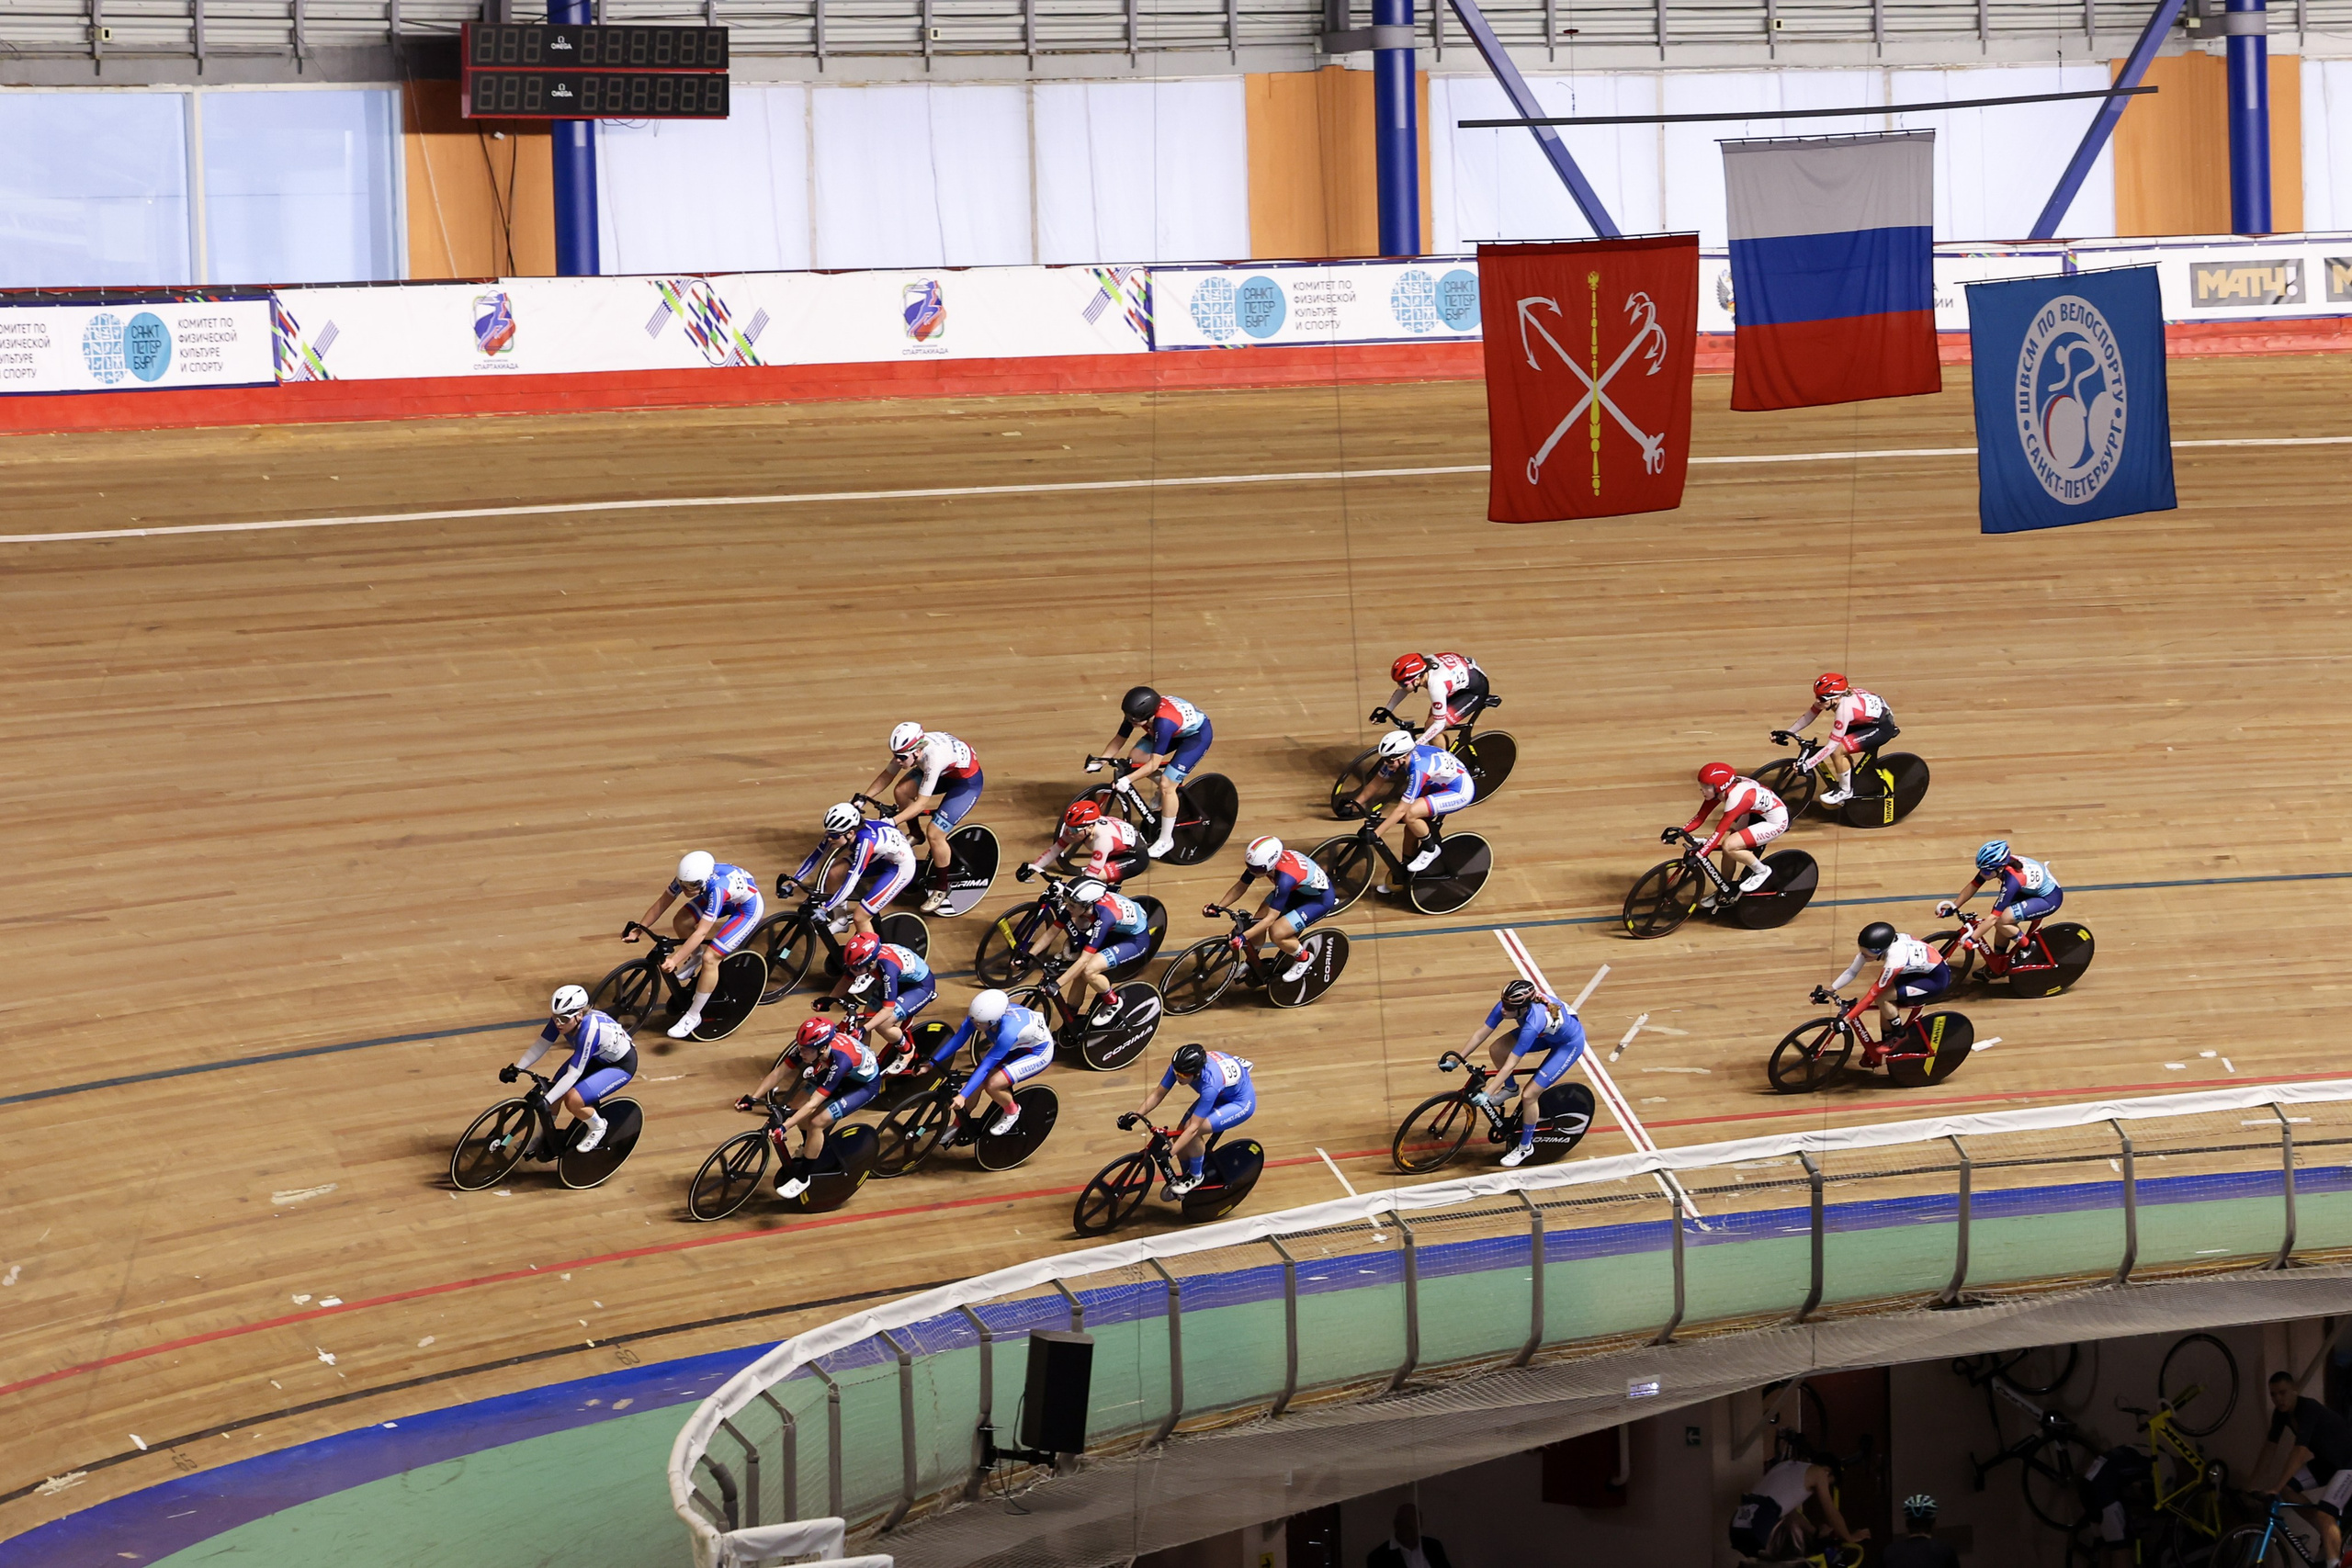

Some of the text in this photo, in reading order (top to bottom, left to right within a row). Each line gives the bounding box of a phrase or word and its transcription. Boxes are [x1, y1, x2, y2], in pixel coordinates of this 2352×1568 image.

[1293, 280, 1352, 291] КОМИТЕТ ПО
[1444, 280, 1475, 293] САНКТ
[2197, 266, 2298, 299] МАТЧ!
[1244, 288, 1274, 300] САНКТ
[1294, 291, 1356, 304] ФИЗИЧЕСКОЙ
[1445, 294, 1476, 307] ПЕТЕР
[1244, 301, 1275, 314] ПЕТЕР
[1295, 307, 1338, 317] КУЛЬТУРЕ
[1245, 315, 1270, 327] БУРГ
[1446, 308, 1471, 321] БУРГ
[34, 323, 46, 333] ПО
[178, 317, 233, 329] КОМИТЕТ ПО
[1295, 321, 1341, 330] И СПОРТУ
[131, 325, 159, 339] САНКТ
[178, 330, 237, 343] ФИЗИЧЕСКОЙ
[0, 336, 51, 349] ИЗИЧЕСКОЙ
[132, 340, 162, 354] ПЕТЕР
[0, 354, 34, 364] УЛЬТУРЕ
[180, 347, 220, 358] КУЛЬТУРЕ
[2019, 302, 2124, 413] ШВСМ ПО ВЕЛОСПОРТУ
[133, 355, 157, 370] БУРГ
[181, 362, 224, 372] И СПОРТУ
[3, 368, 37, 379] СПОРТУ
[2026, 420, 2122, 499] САНКТ-ПЕТЕРБУРГ
[1456, 671, 1466, 685] 42
[1869, 698, 1880, 711] 36
[1444, 758, 1454, 770] 38
[1759, 795, 1770, 808] 40
[1756, 819, 1788, 841] МОСКВА
[1700, 856, 1731, 893] ARGON 18
[2030, 871, 2040, 882] 56
[949, 878, 989, 889] ORIMA
[1102, 949, 1117, 969] BLR
[1323, 936, 1334, 983] CORIMA
[1914, 948, 1923, 959] 41
[1102, 1025, 1153, 1062] CORIMA
[1018, 1059, 1048, 1075] LOKOSPHINX
[1226, 1065, 1238, 1079] 39
[1482, 1101, 1498, 1122] GON
[2160, 1426, 2202, 1466] LOOK
[172, 1453, 198, 1472] 65
